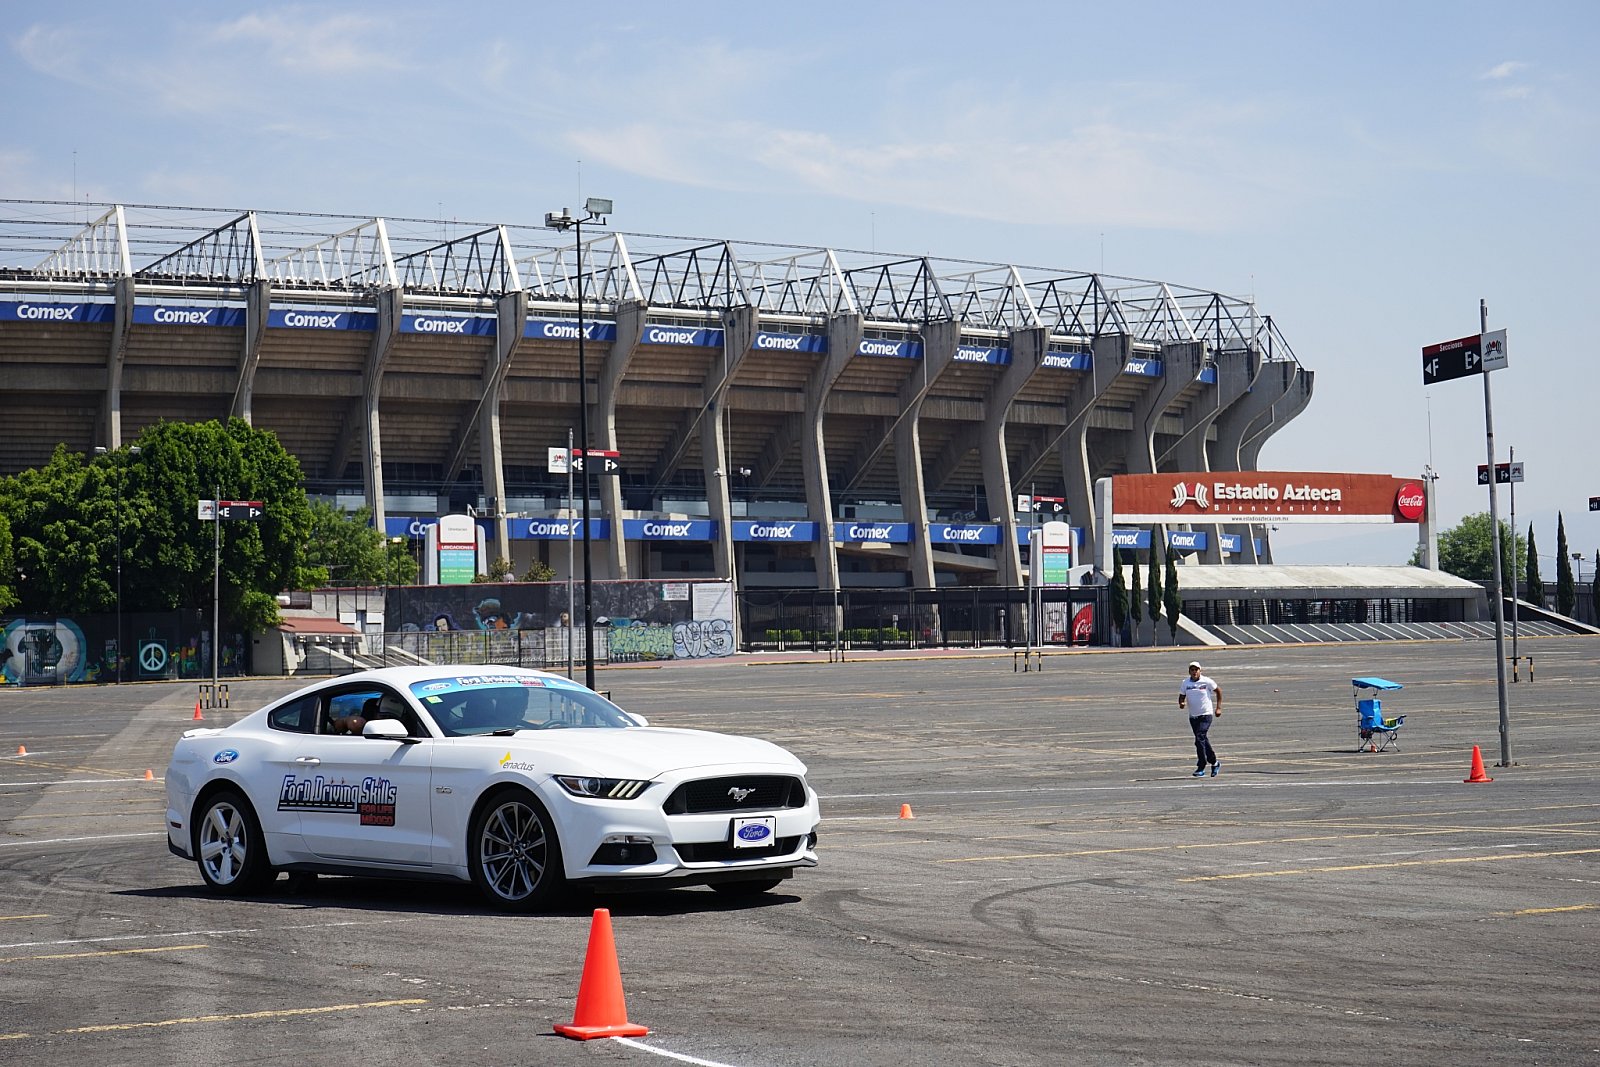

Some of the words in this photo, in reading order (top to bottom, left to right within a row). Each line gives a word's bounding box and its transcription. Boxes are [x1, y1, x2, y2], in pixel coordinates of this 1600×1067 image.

[16, 304, 78, 321] Comex
[153, 308, 213, 325] Comex
[284, 312, 341, 329] Comex
[413, 317, 469, 334] Comex
[543, 323, 594, 340] Comex
[649, 328, 698, 345] Comex
[757, 333, 803, 352] Comex
[859, 341, 902, 357] Comex
[1042, 354, 1075, 369] omex
[1126, 362, 1147, 374] mex
[1432, 358, 1439, 377] F
[1464, 351, 1473, 370] E
[604, 459, 612, 472] F
[1213, 482, 1279, 501] Estadio
[1283, 483, 1342, 502] Azteca
[224, 508, 229, 517] E
[250, 508, 255, 517] F
[1214, 504, 1342, 512] Bienvenidos
[529, 520, 580, 537] Comex
[643, 521, 693, 538] Comex
[749, 523, 797, 539] Comex
[849, 524, 893, 540] Comex
[942, 526, 984, 541] Comex
[1171, 533, 1197, 547] Comex
[502, 761, 535, 772] enactus
[314, 775, 360, 812] Driving
[361, 776, 398, 805] Skills
[743, 826, 764, 839] Ford
